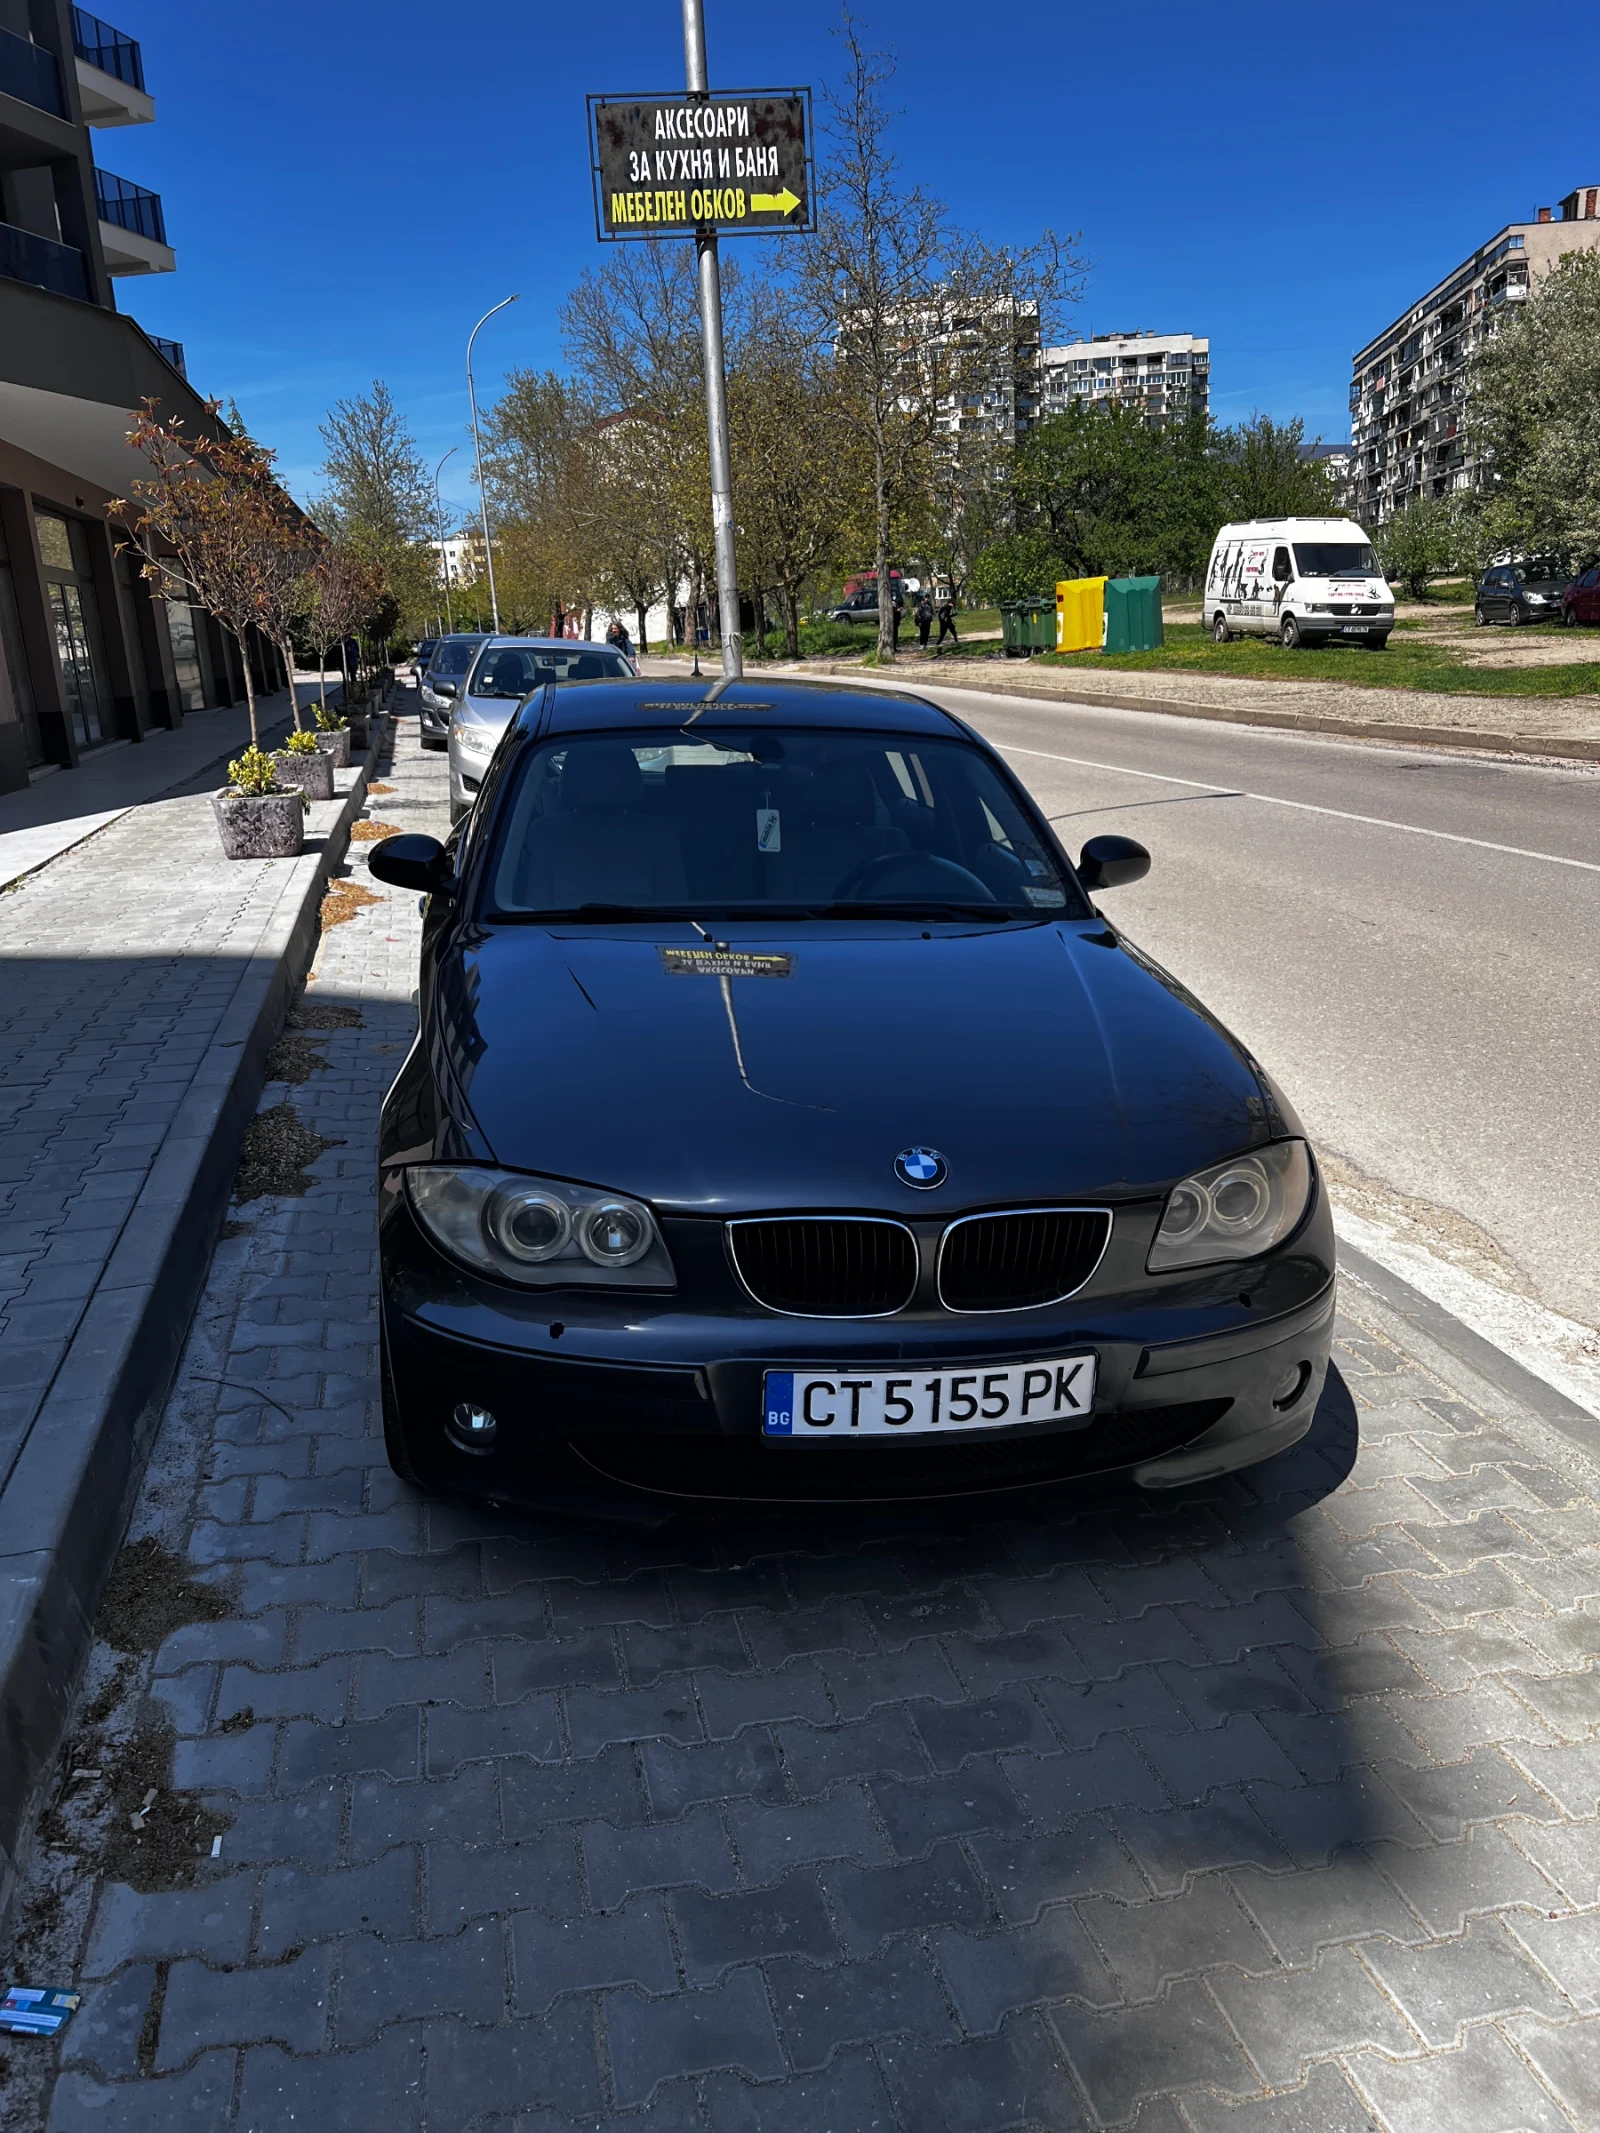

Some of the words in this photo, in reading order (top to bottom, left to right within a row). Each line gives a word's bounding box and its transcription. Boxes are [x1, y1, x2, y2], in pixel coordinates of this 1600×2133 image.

[655, 106, 749, 140] АКСЕСОАРИ
[629, 151, 651, 182] ЗА
[655, 148, 713, 180] КУХНЯ
[718, 148, 731, 179] И
[735, 146, 779, 177] БАНЯ
[611, 191, 686, 223] МЕБЕЛЕН
[690, 188, 746, 220] ОБКОВ
[898, 1148, 940, 1161] BMW
[803, 1380, 872, 1427] CT
[884, 1373, 1010, 1426] 5155
[1020, 1363, 1085, 1416] PK
[768, 1411, 790, 1425] BG
